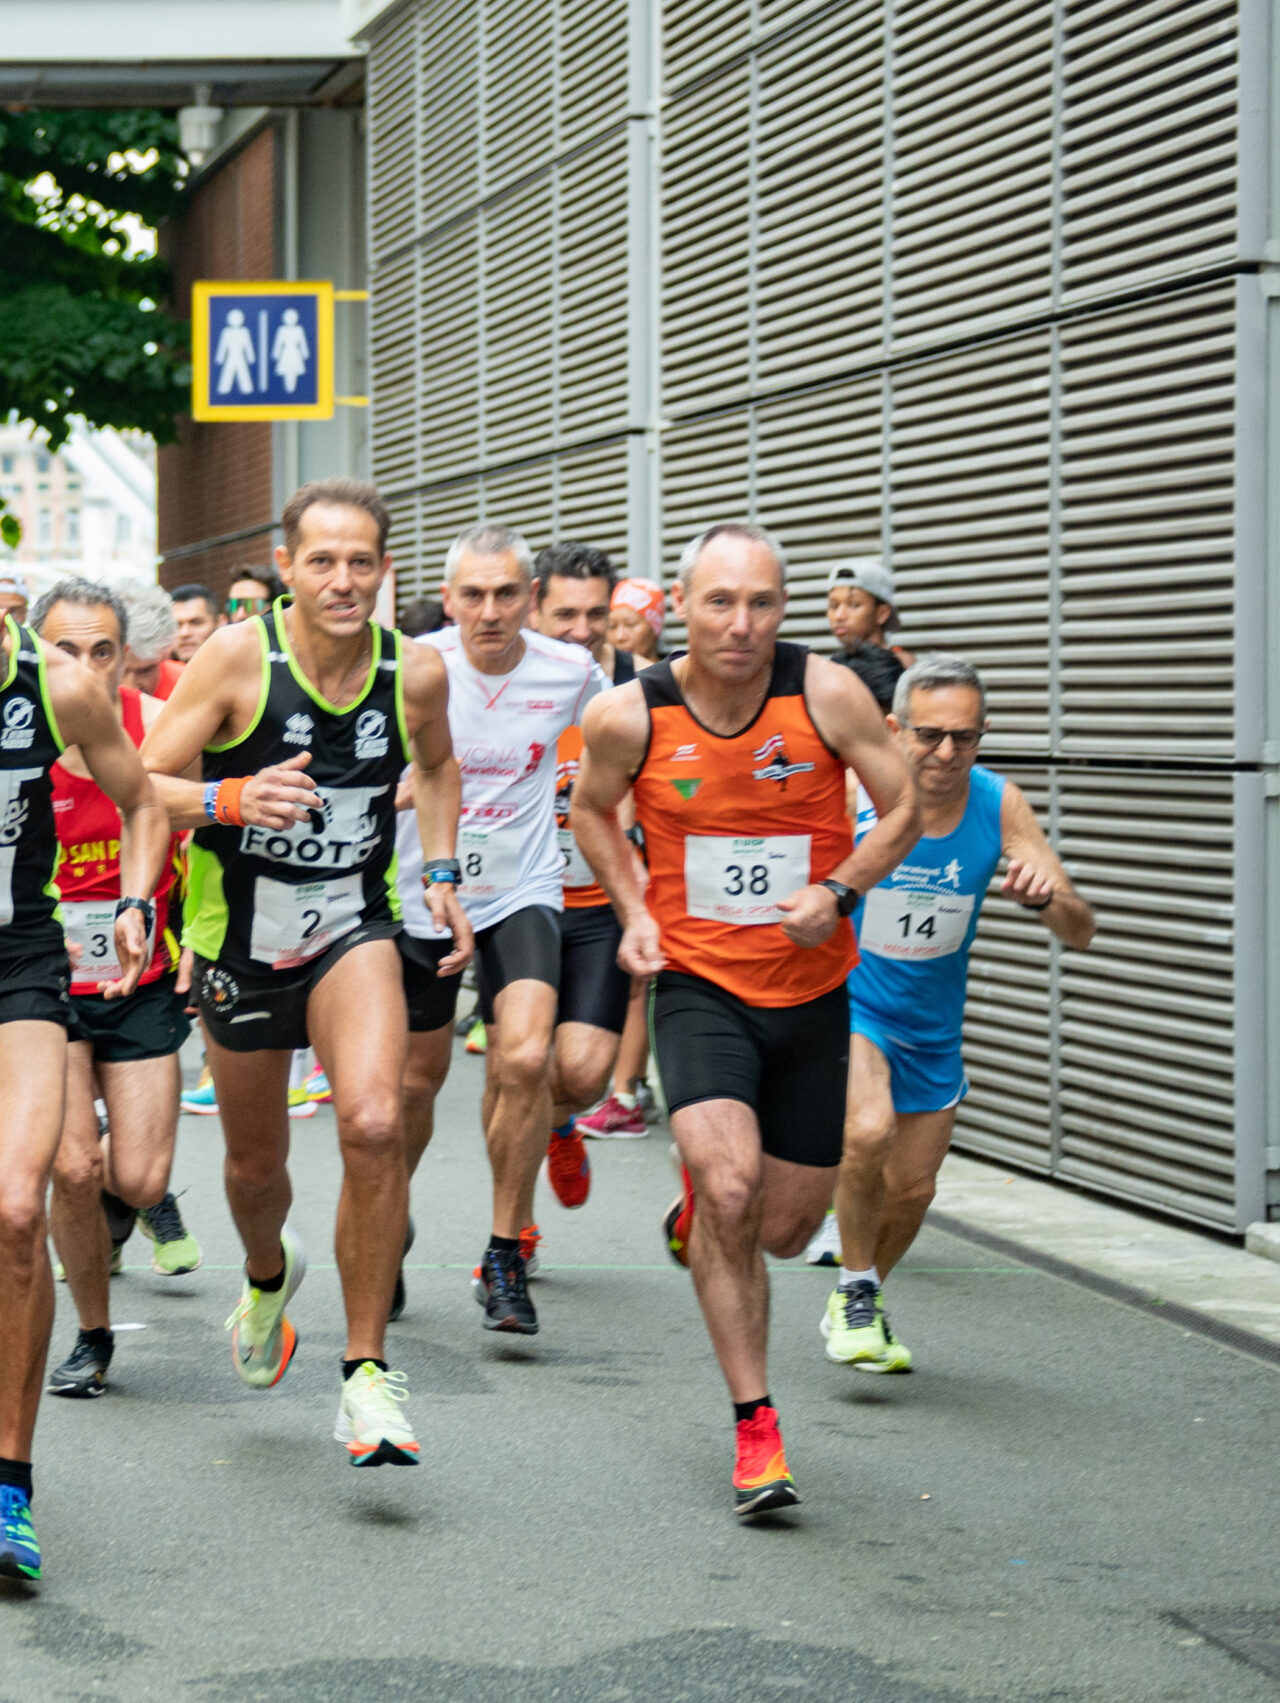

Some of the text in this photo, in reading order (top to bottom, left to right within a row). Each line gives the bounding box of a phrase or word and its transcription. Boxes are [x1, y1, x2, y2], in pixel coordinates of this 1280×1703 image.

[466, 852, 482, 877] 8
[725, 864, 768, 896] 38
[301, 909, 321, 939] 2
[897, 912, 937, 939] 14
[91, 933, 108, 957] 3
